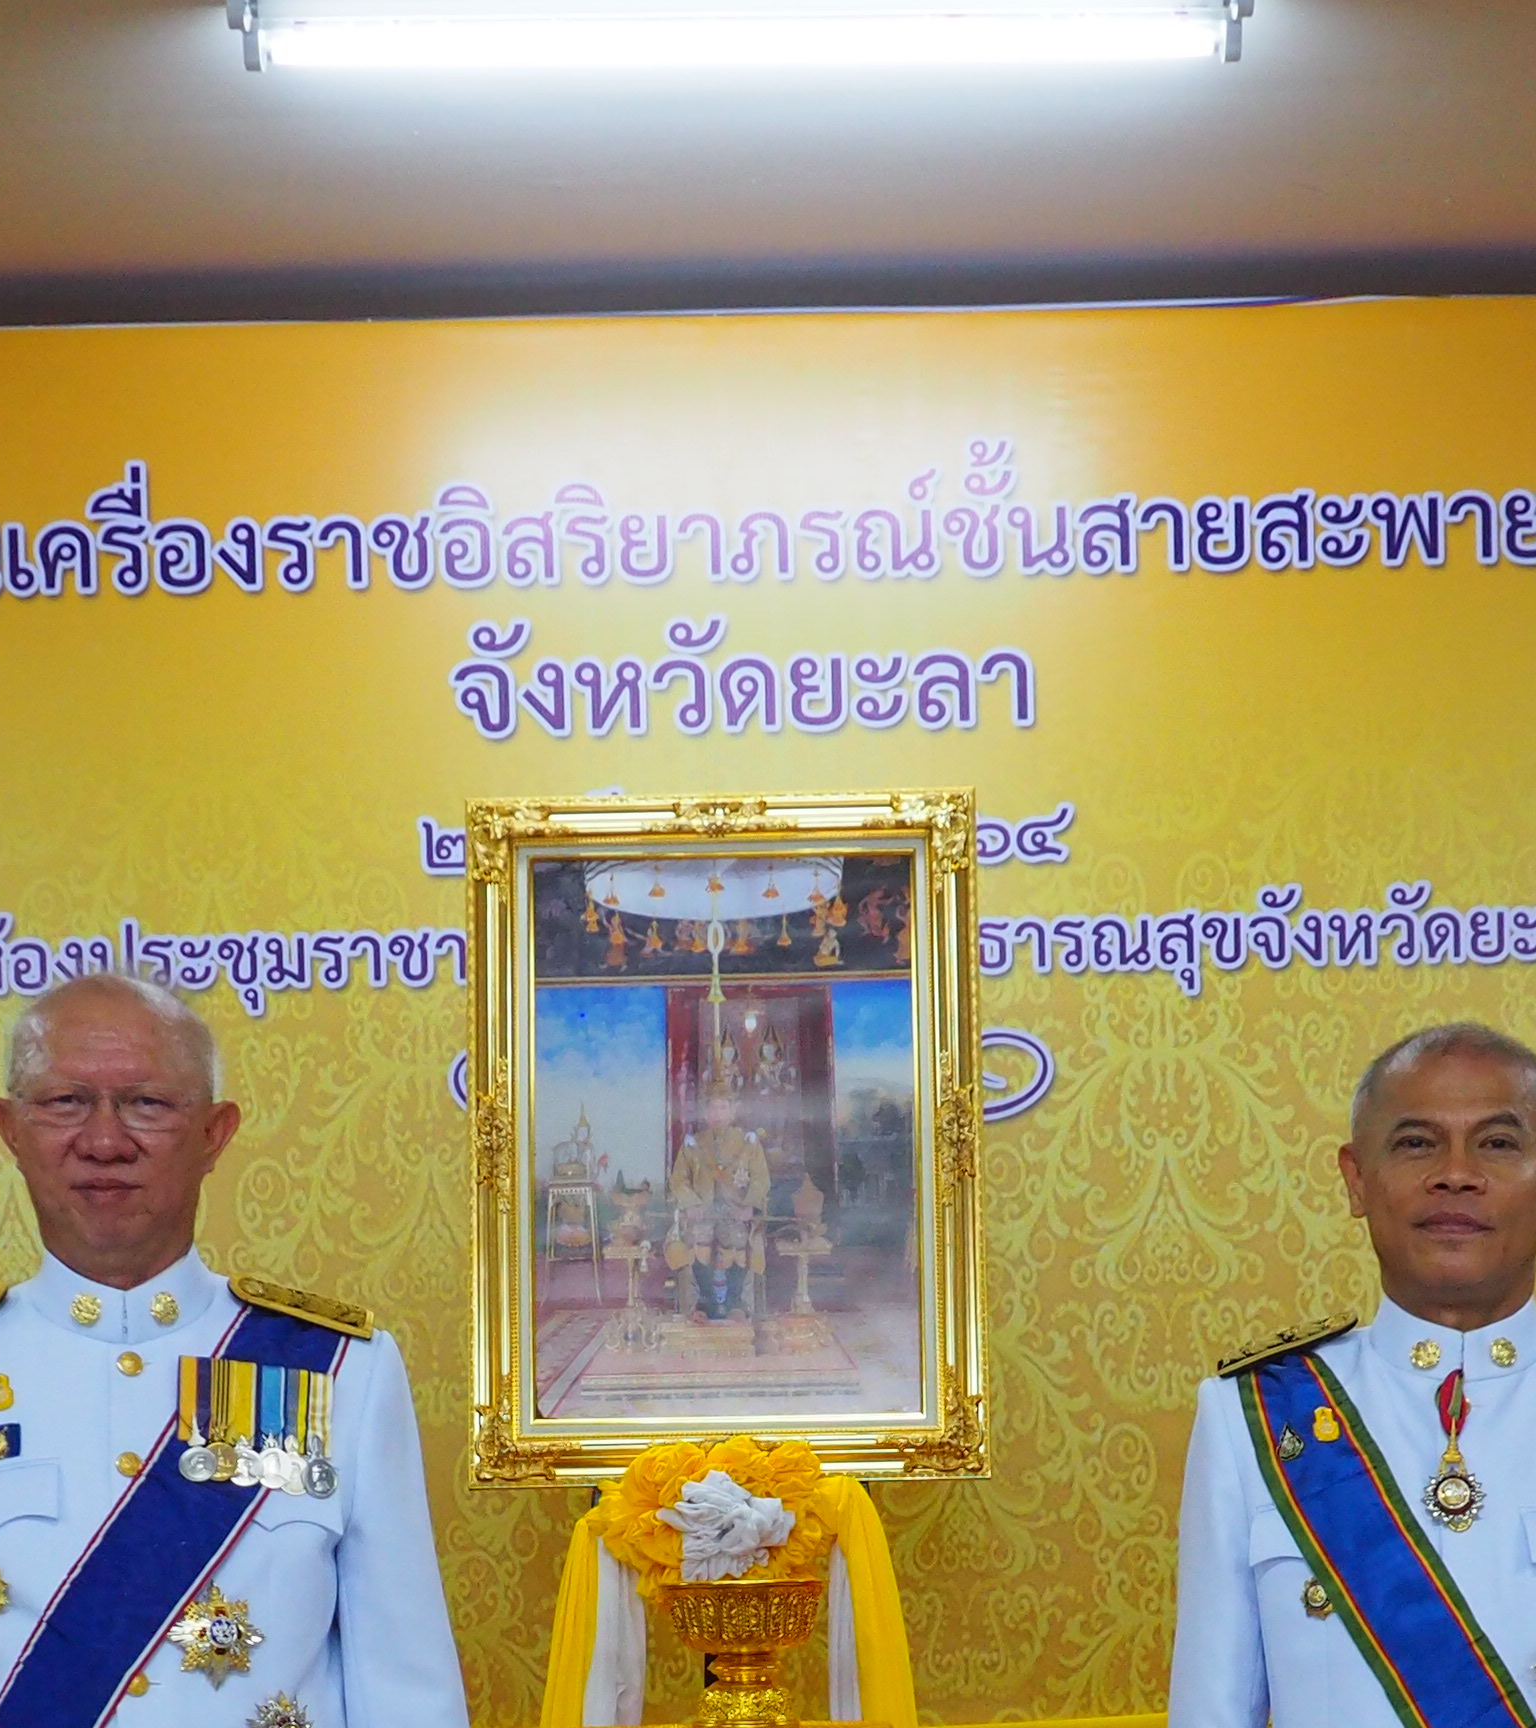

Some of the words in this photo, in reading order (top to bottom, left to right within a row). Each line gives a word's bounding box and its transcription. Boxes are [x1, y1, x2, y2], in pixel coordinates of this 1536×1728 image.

[454, 618, 1032, 736] จังหวัดยะลา
